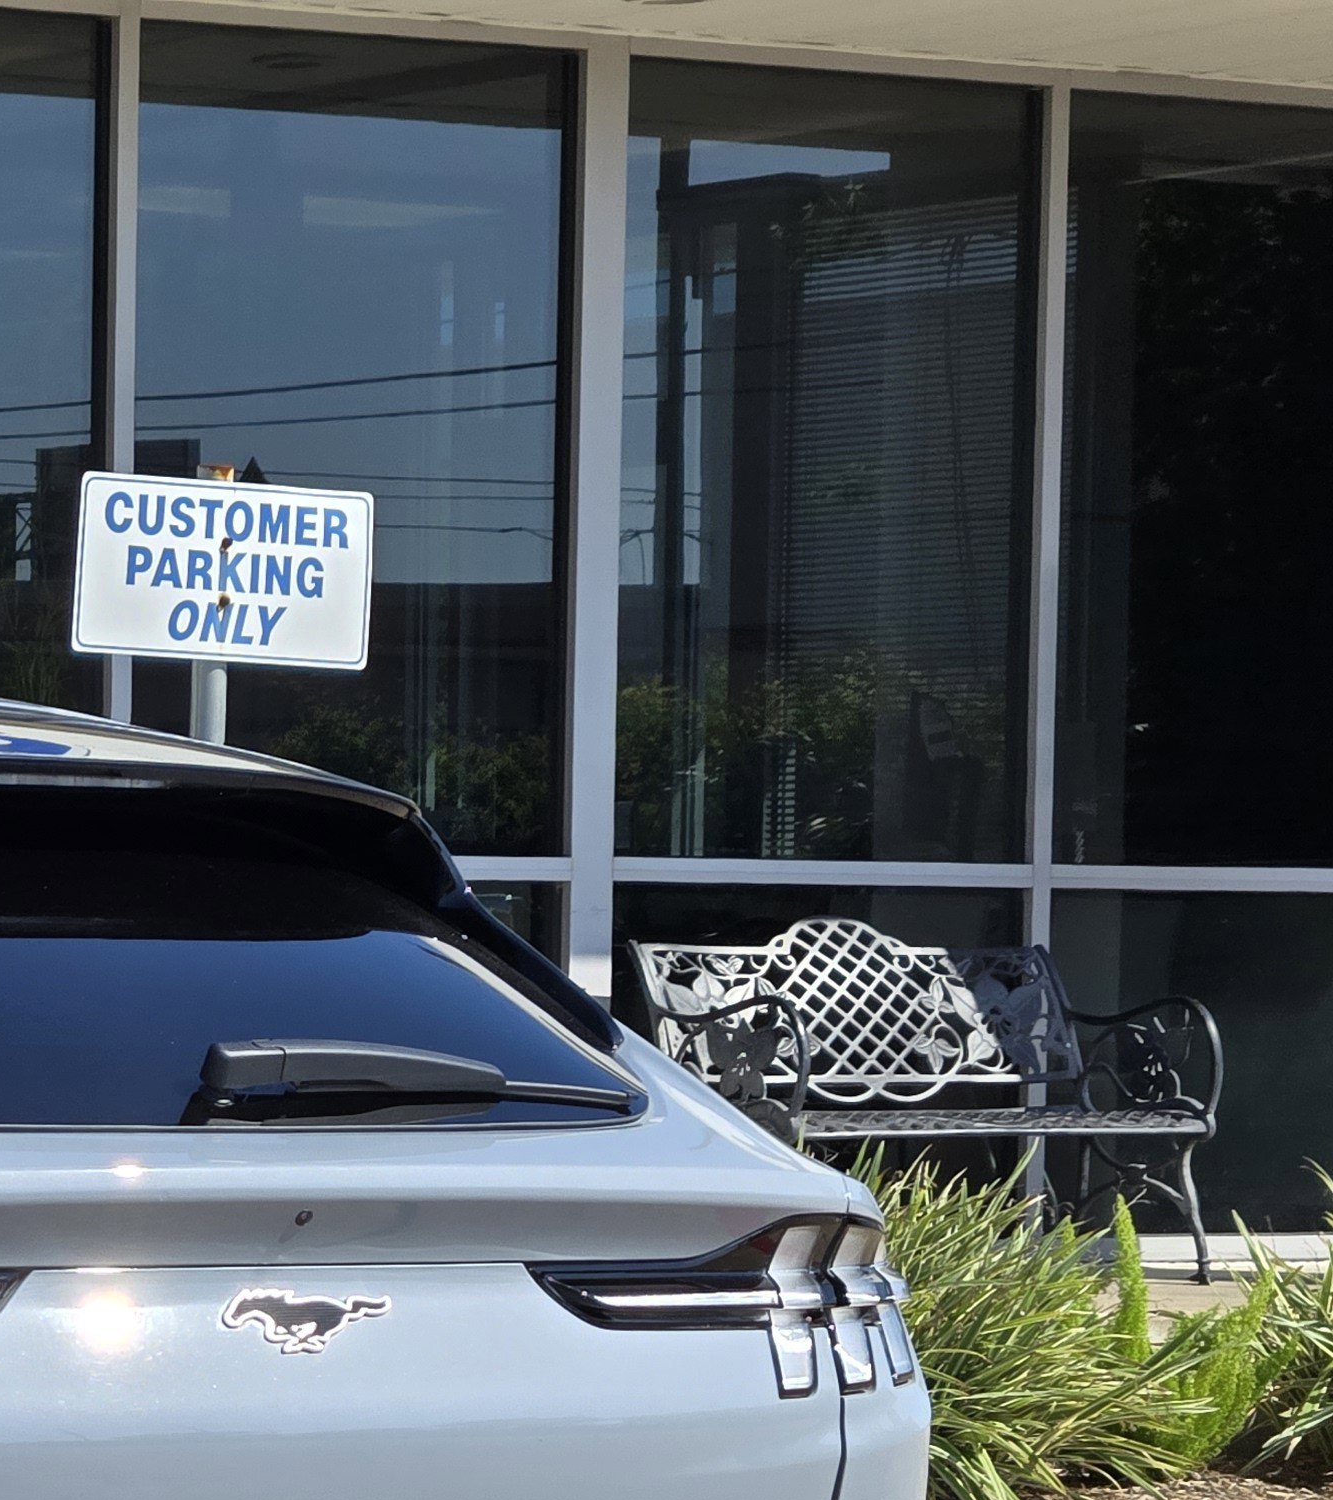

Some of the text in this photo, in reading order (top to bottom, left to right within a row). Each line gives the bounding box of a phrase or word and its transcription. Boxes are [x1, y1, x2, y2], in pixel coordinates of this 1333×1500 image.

[104, 490, 349, 550] CUSTOMER
[125, 544, 325, 599] PARKING
[167, 599, 288, 647] ONLY
